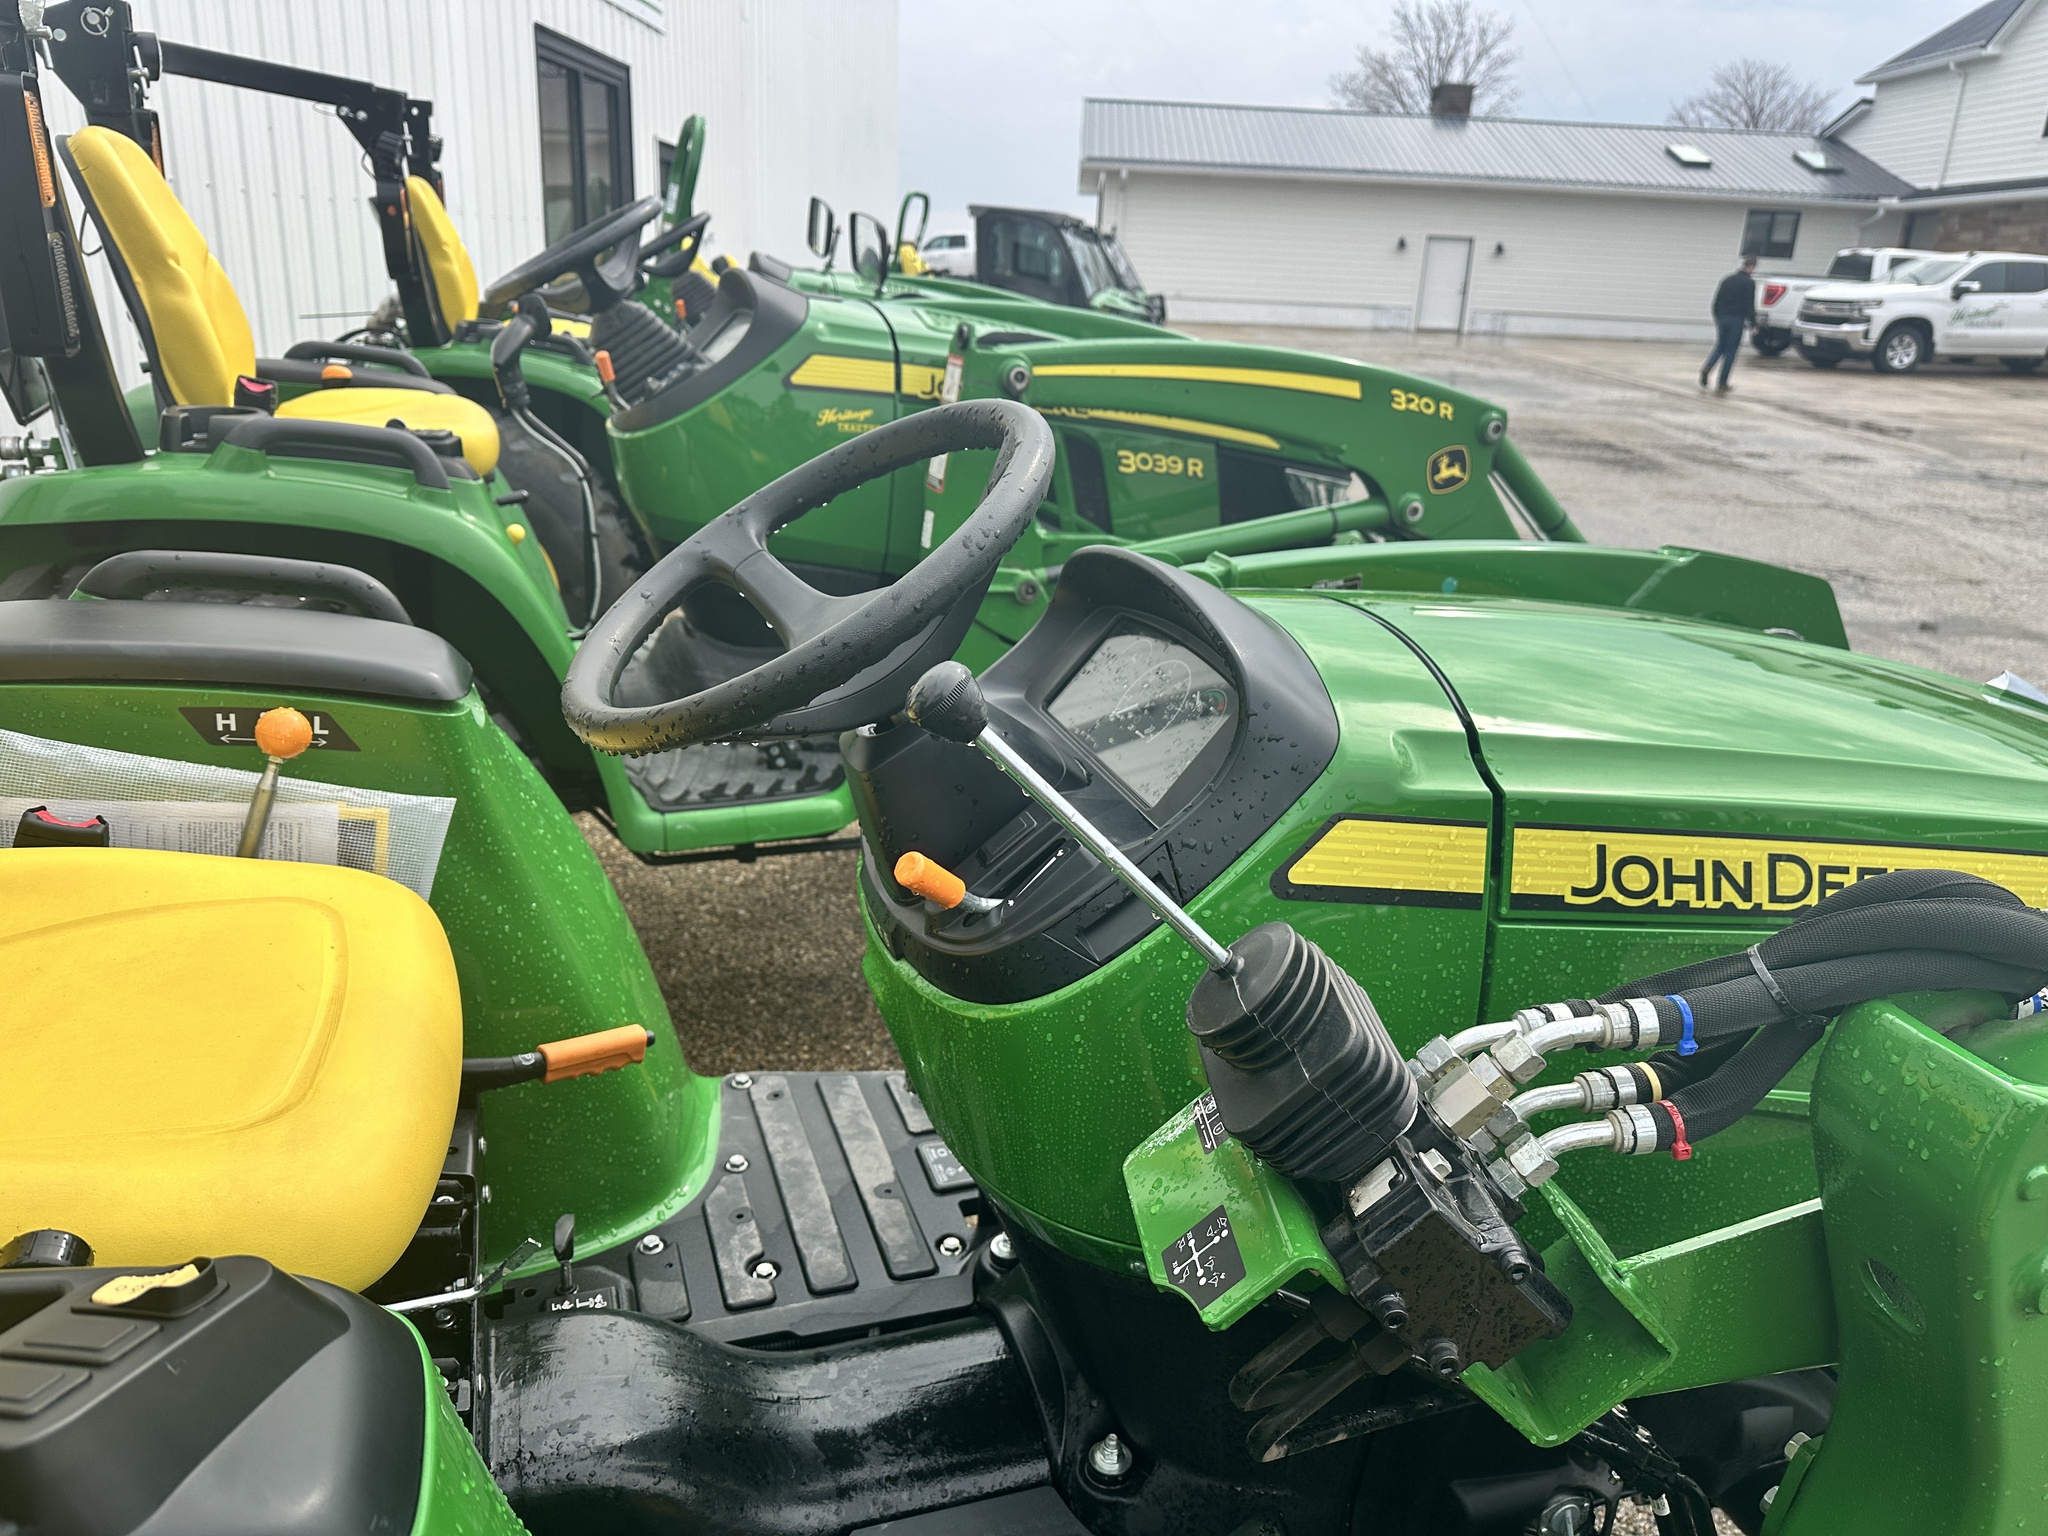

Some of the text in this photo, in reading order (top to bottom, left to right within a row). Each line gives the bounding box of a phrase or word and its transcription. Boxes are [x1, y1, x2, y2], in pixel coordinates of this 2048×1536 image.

[816, 407, 874, 426] Heritage
[1390, 388, 1454, 421] 320 R
[1116, 449, 1204, 478] 3039 R
[215, 713, 329, 735] H L
[1571, 844, 1753, 903] JOHN
